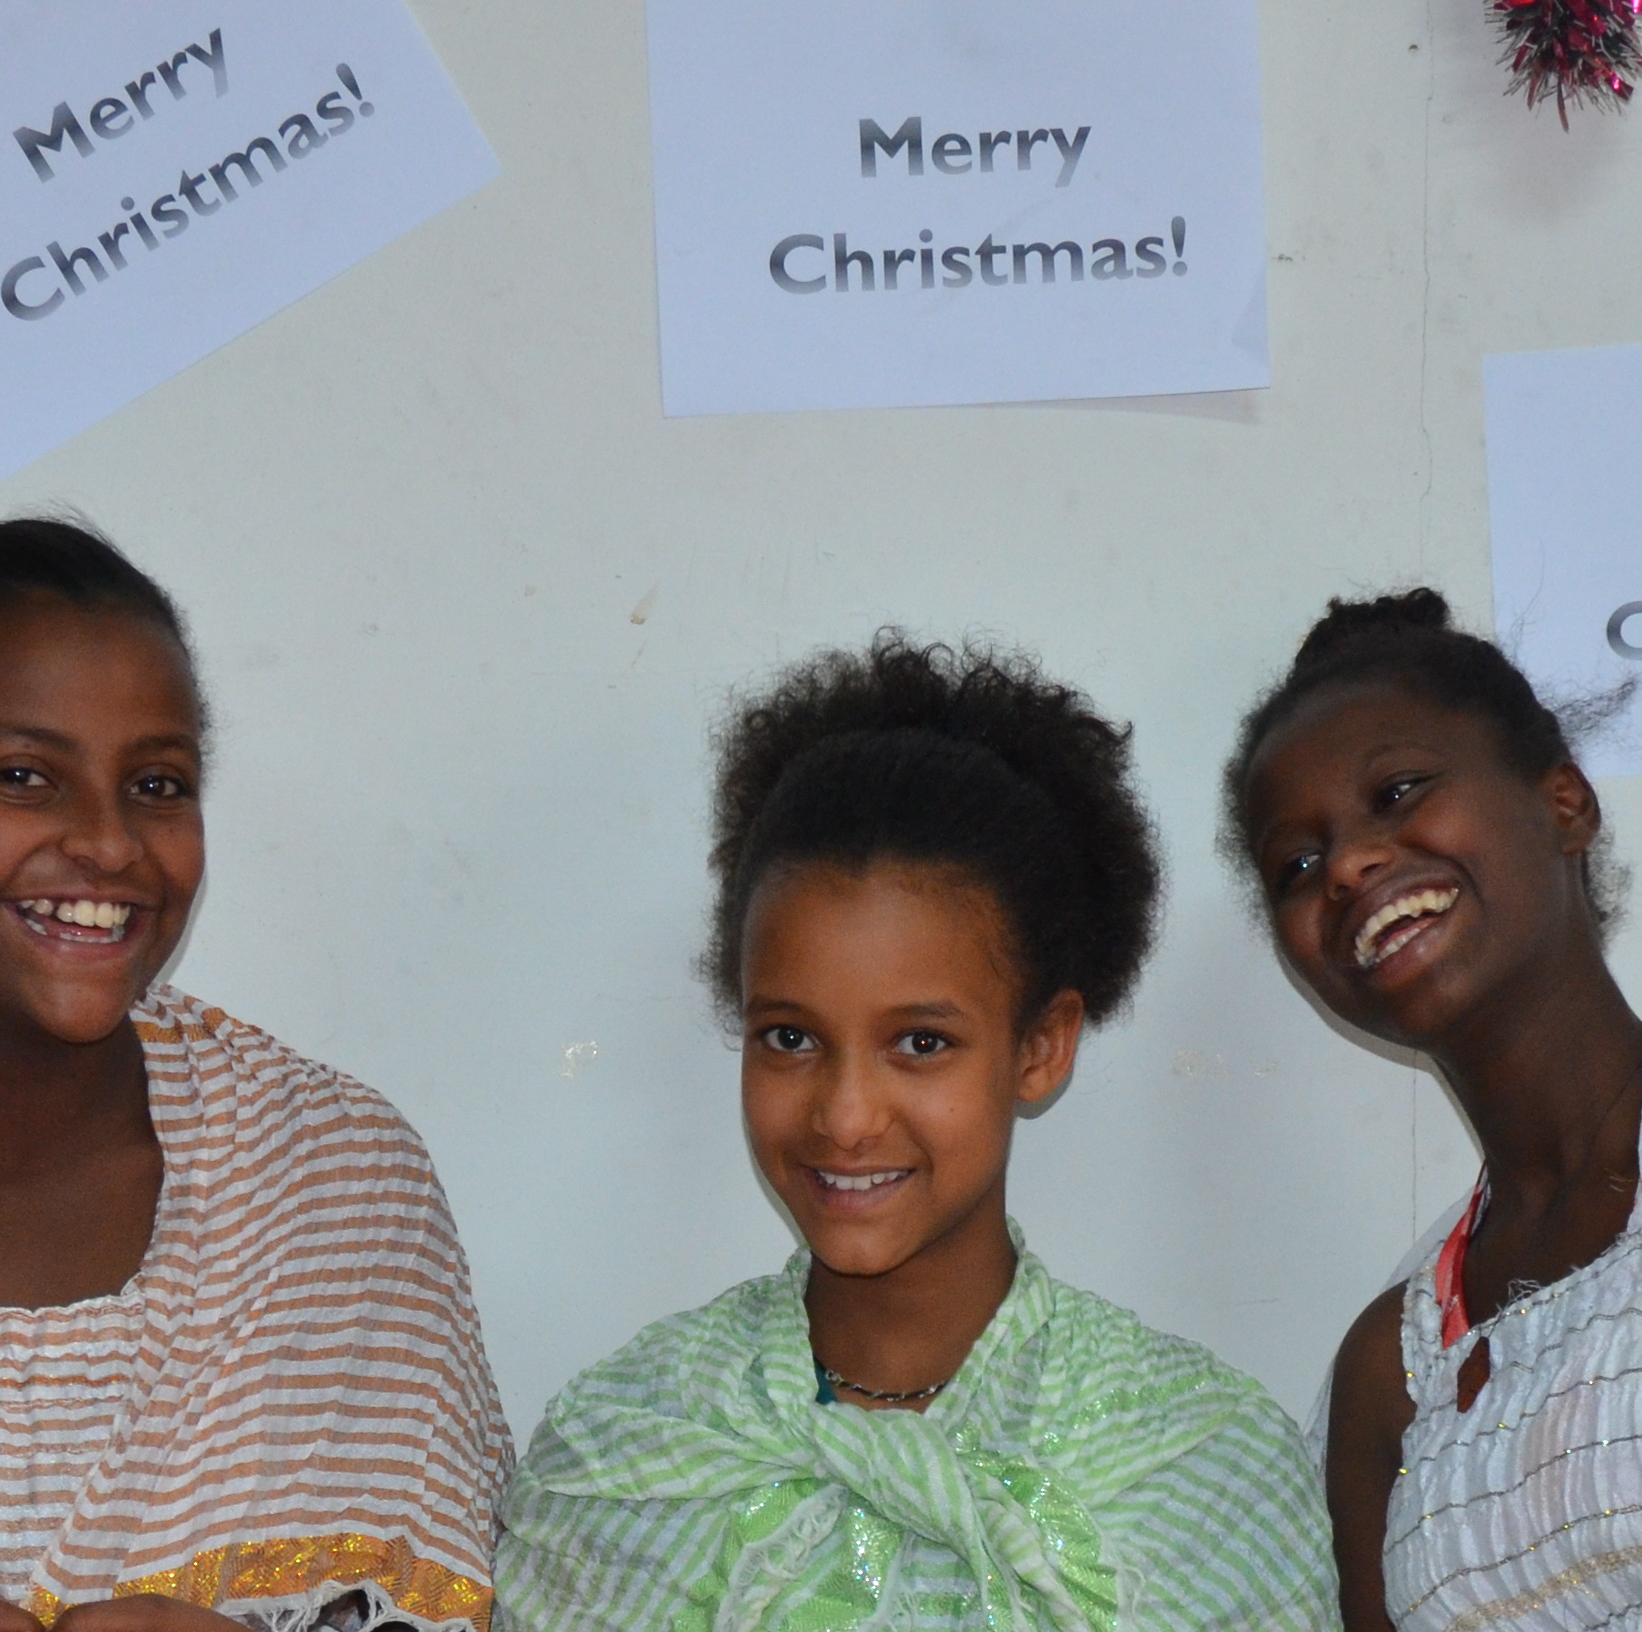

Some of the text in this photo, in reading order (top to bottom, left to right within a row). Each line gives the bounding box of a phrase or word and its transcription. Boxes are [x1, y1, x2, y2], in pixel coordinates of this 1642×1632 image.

[12, 27, 230, 184] Merry
[858, 116, 1092, 188] Merry
[0, 62, 375, 322] Christmas!
[769, 215, 1189, 296] Christmas!
